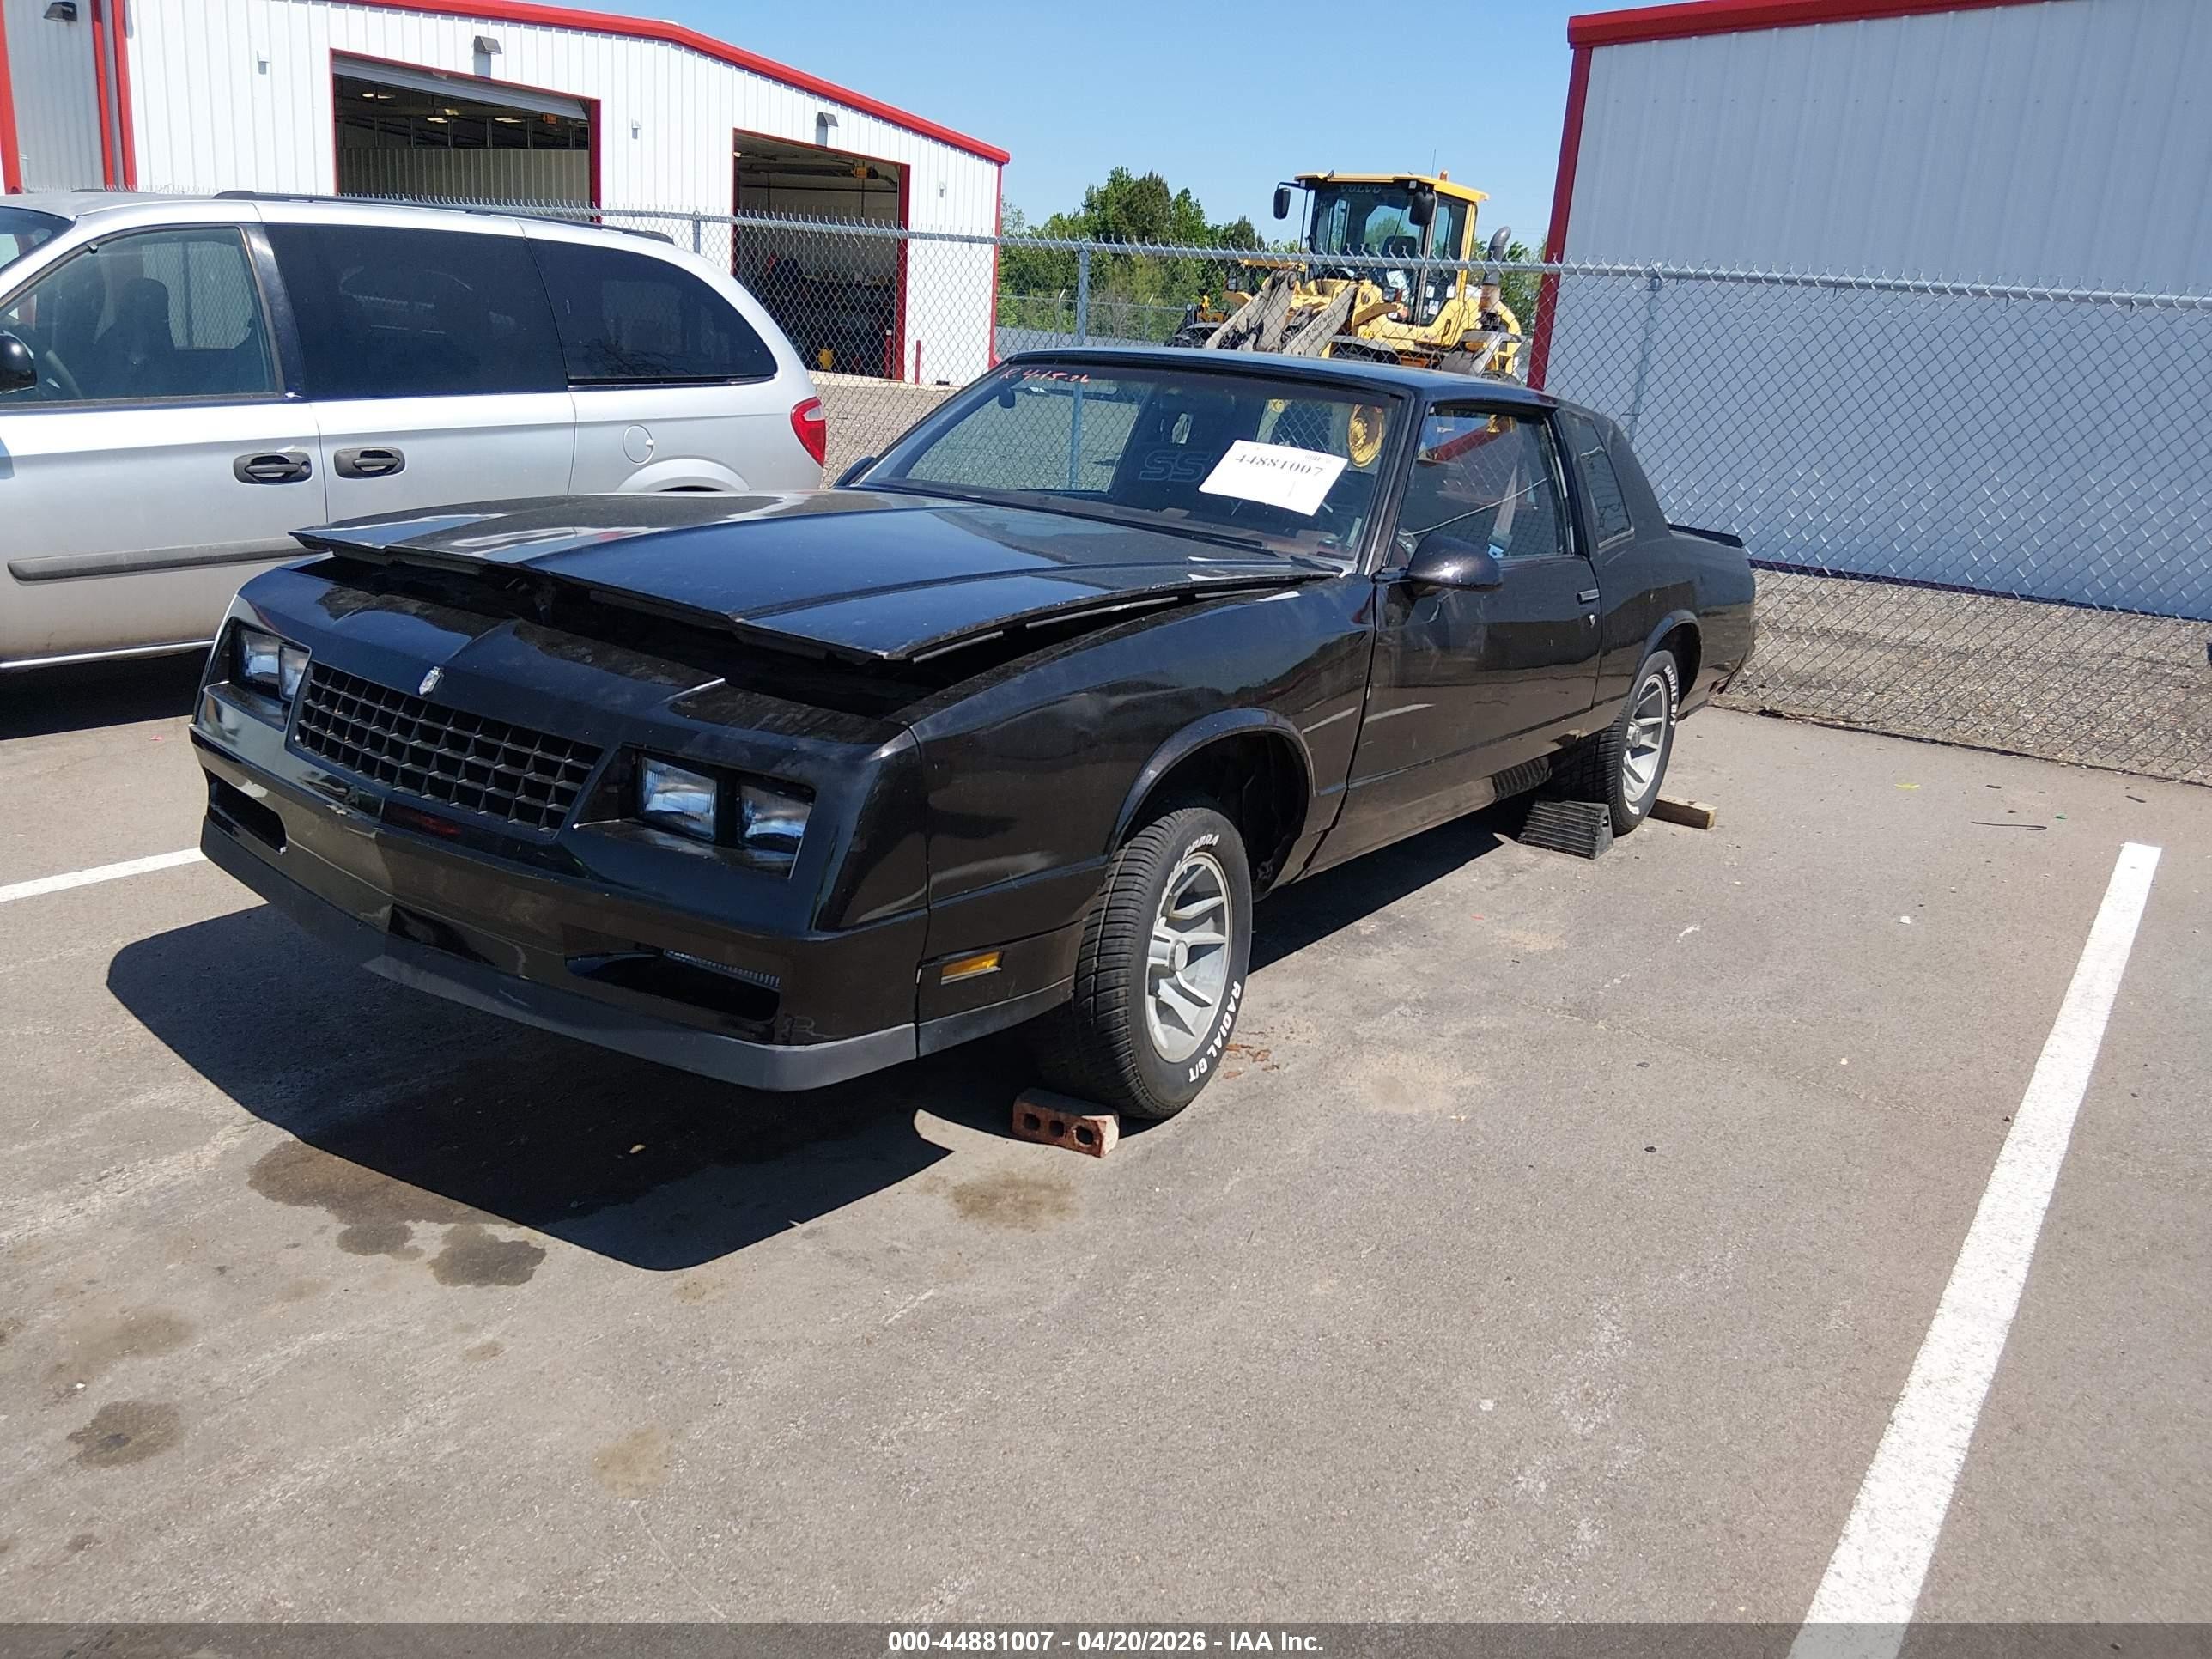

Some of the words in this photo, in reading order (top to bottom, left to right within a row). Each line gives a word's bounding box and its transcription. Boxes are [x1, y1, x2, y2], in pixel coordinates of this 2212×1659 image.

[1340, 185, 1382, 194] VOLVO
[1235, 454, 1324, 477] 44881007
[1182, 834, 1219, 860] COBRA
[1206, 981, 1242, 1058] RADIAL
[1188, 1058, 1208, 1083] G/T
